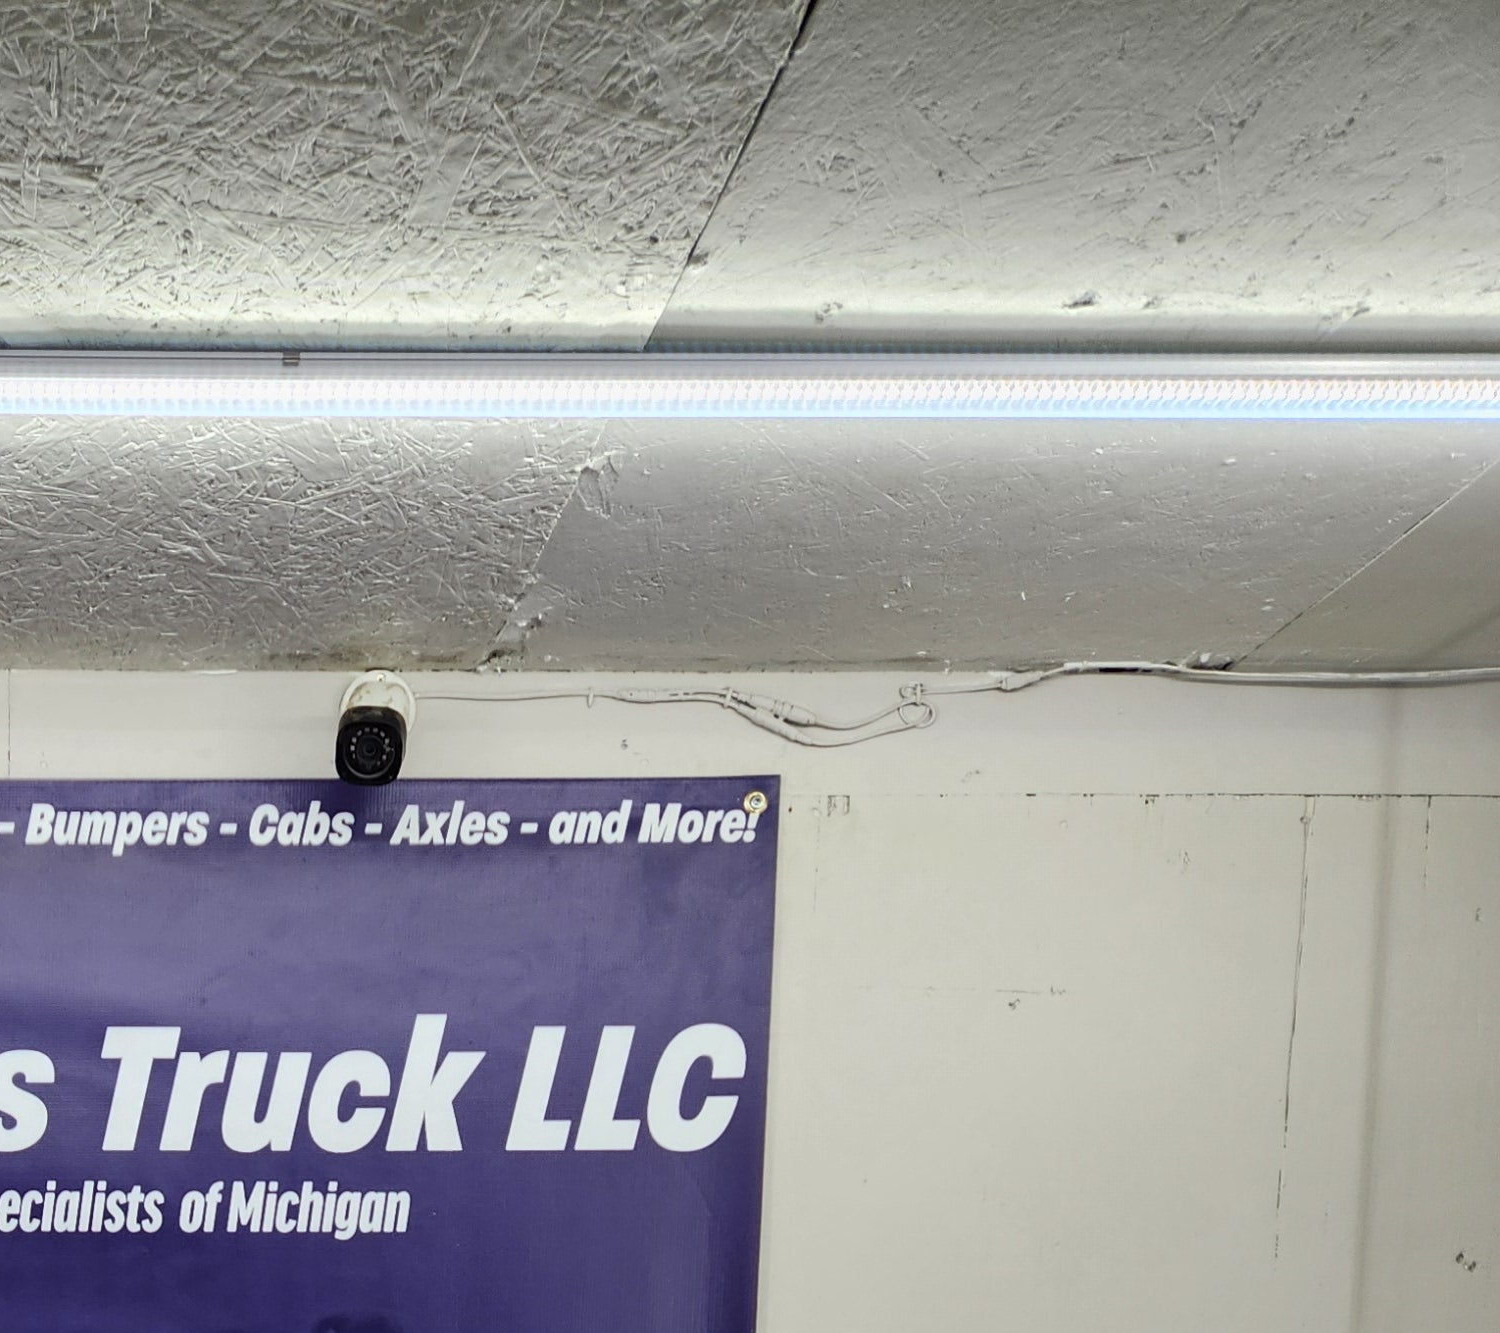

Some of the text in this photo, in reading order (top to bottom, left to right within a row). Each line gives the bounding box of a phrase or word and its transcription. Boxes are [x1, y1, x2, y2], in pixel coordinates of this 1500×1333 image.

[24, 803, 210, 857] Bumpers
[248, 800, 355, 846] Cabs
[389, 800, 511, 846] Axles
[548, 799, 633, 845] and
[637, 802, 761, 844] More!
[100, 1013, 488, 1154] Truck
[505, 1023, 748, 1152] LLC
[179, 1181, 224, 1233] of
[226, 1180, 411, 1241] Michigan
